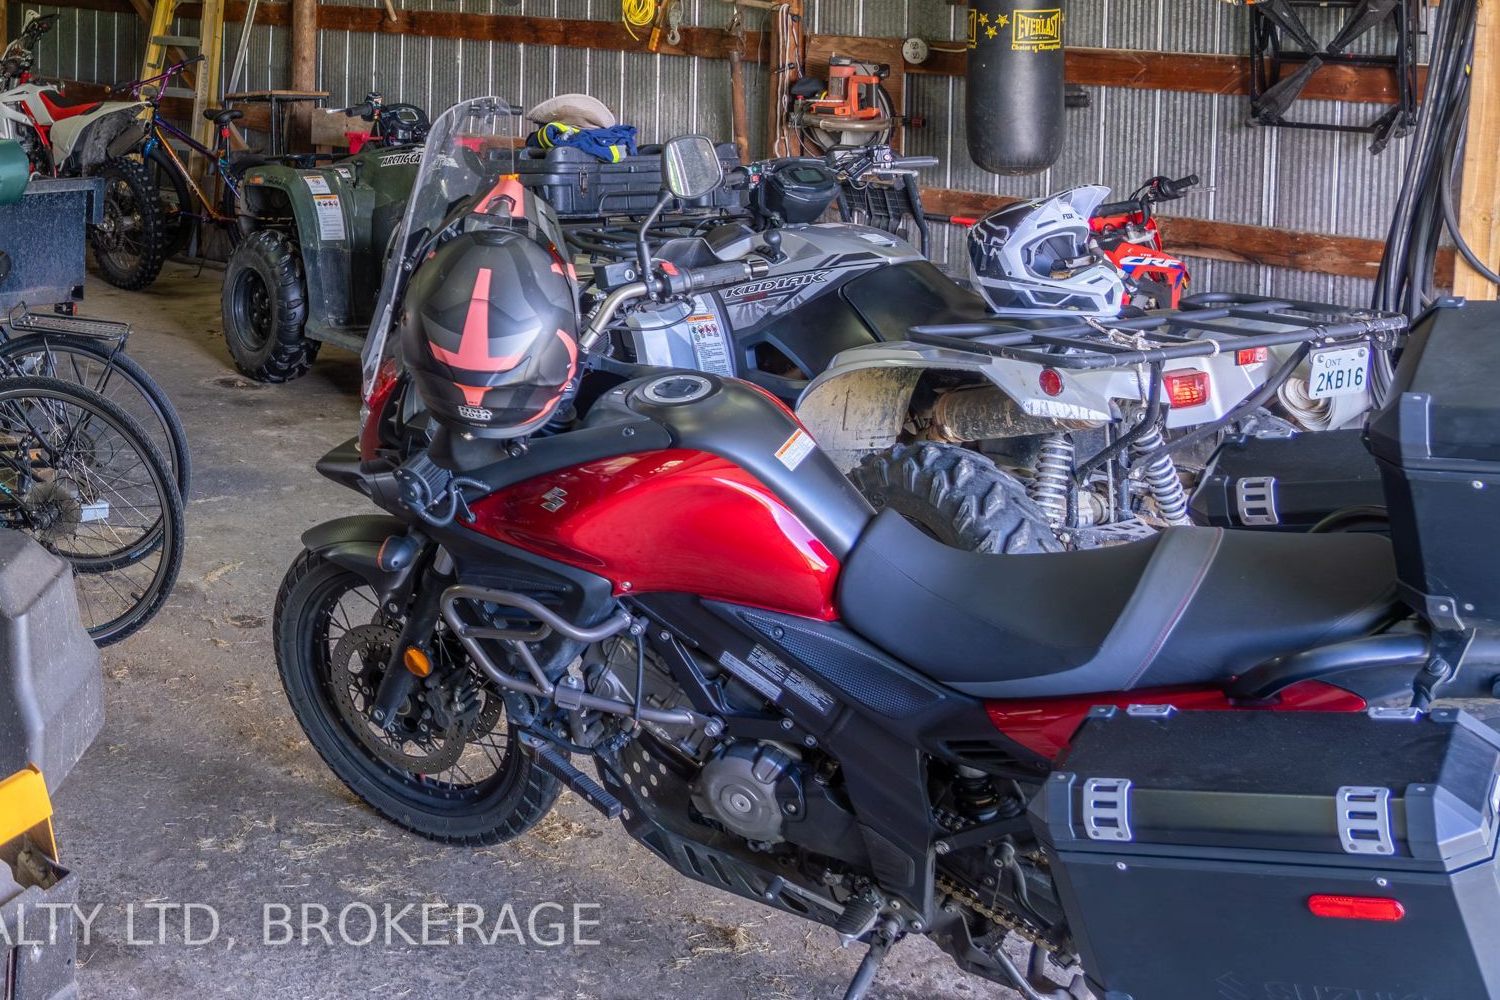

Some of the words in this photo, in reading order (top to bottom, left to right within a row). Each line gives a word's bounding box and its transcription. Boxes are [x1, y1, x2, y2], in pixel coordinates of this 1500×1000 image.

[1017, 11, 1060, 41] EVERLAST
[381, 153, 410, 167] ARCTIC
[1062, 212, 1075, 220] FOX
[1120, 256, 1185, 267] CRF
[725, 269, 835, 299] KODIAK
[1316, 366, 1364, 393] 2KB16
